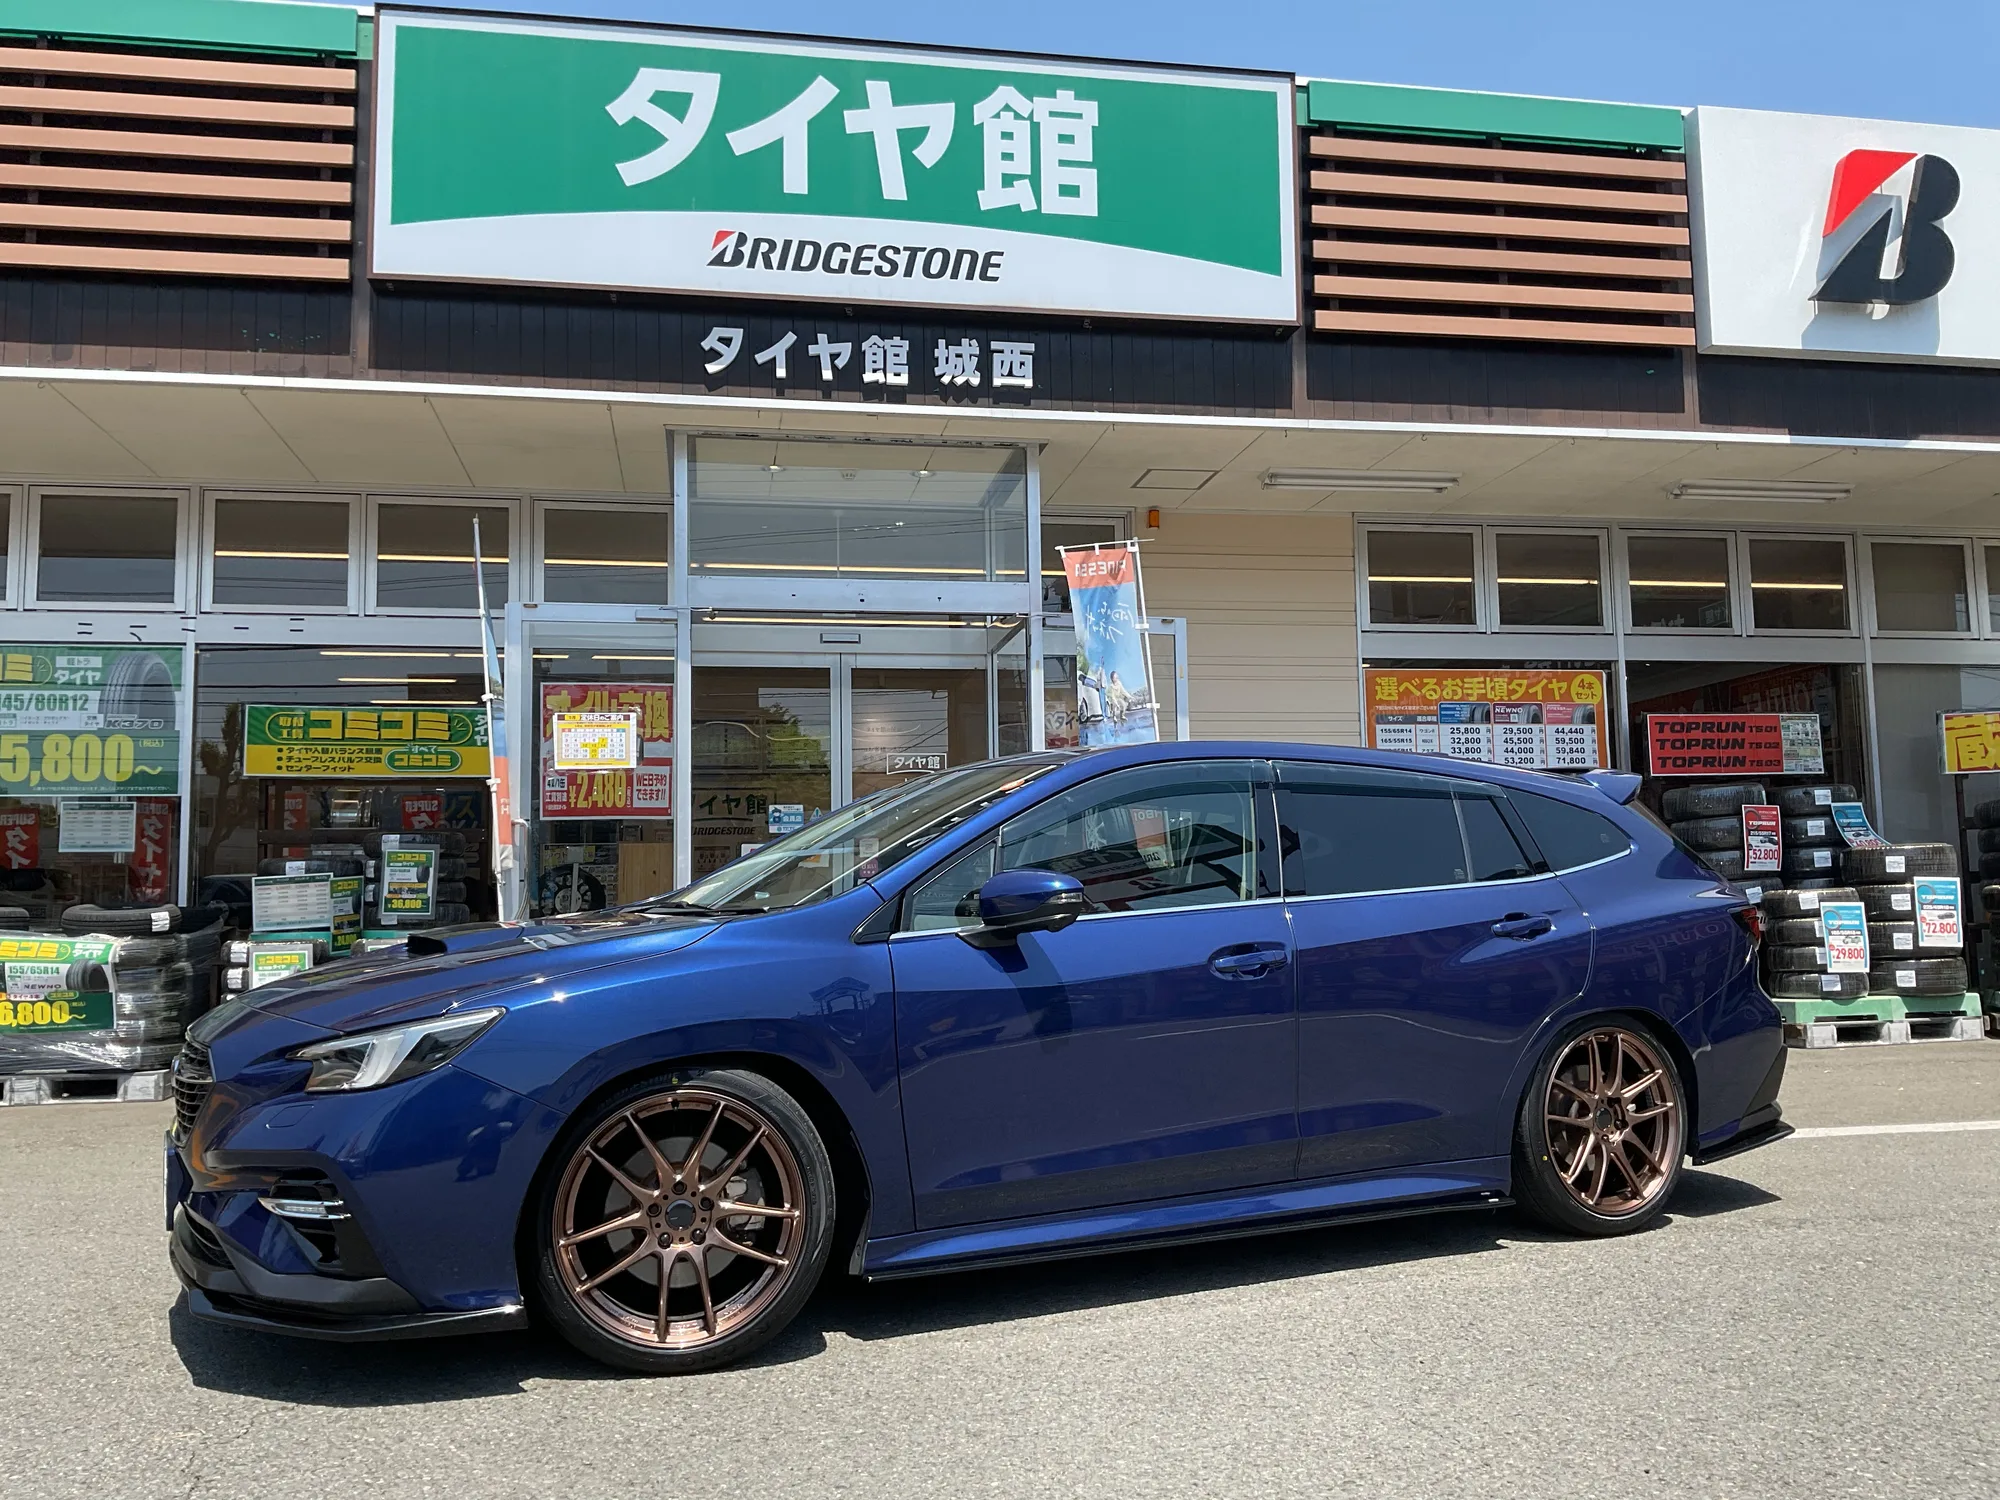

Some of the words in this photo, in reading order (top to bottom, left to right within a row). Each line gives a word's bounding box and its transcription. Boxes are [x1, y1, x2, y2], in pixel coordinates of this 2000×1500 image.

[605, 67, 1099, 217] タイヤ館
[706, 229, 1004, 283] BRIDGESTONE
[700, 327, 910, 387] タイヤ館
[933, 337, 1036, 388] 城西
[54, 669, 101, 686] タイヤ
[1577, 677, 1596, 691] 4本
[1375, 676, 1569, 702] 選べるお手頃タイヤ
[1574, 690, 1598, 700] セット
[104, 719, 164, 730] K370
[309, 710, 451, 740] コミコミ
[1654, 722, 1747, 734] TOPRUN
[1450, 727, 1481, 736] 25,800
[1502, 727, 1533, 735] 29,500
[1554, 727, 1584, 735] 44,440
[1450, 737, 1481, 746] 32,800
[1503, 737, 1534, 745] 45,500
[1555, 737, 1585, 745] 59,500
[1655, 738, 1747, 750] TOPRUN
[1450, 747, 1482, 755] 33,800
[1503, 747, 1534, 755] 44,000
[1555, 747, 1586, 755] 59,840
[394, 754, 452, 767] コミコミ
[894, 756, 940, 769] タイヤ館
[1504, 757, 1535, 765] 53,200
[1556, 757, 1586, 765] 71,800
[1657, 756, 1747, 769] TOPRUN
[636, 773, 667, 787] WEB予約
[691, 793, 769, 815] イヤ館
[72, 949, 104, 958] タイヤ
[8, 965, 61, 975] 155/65R14
